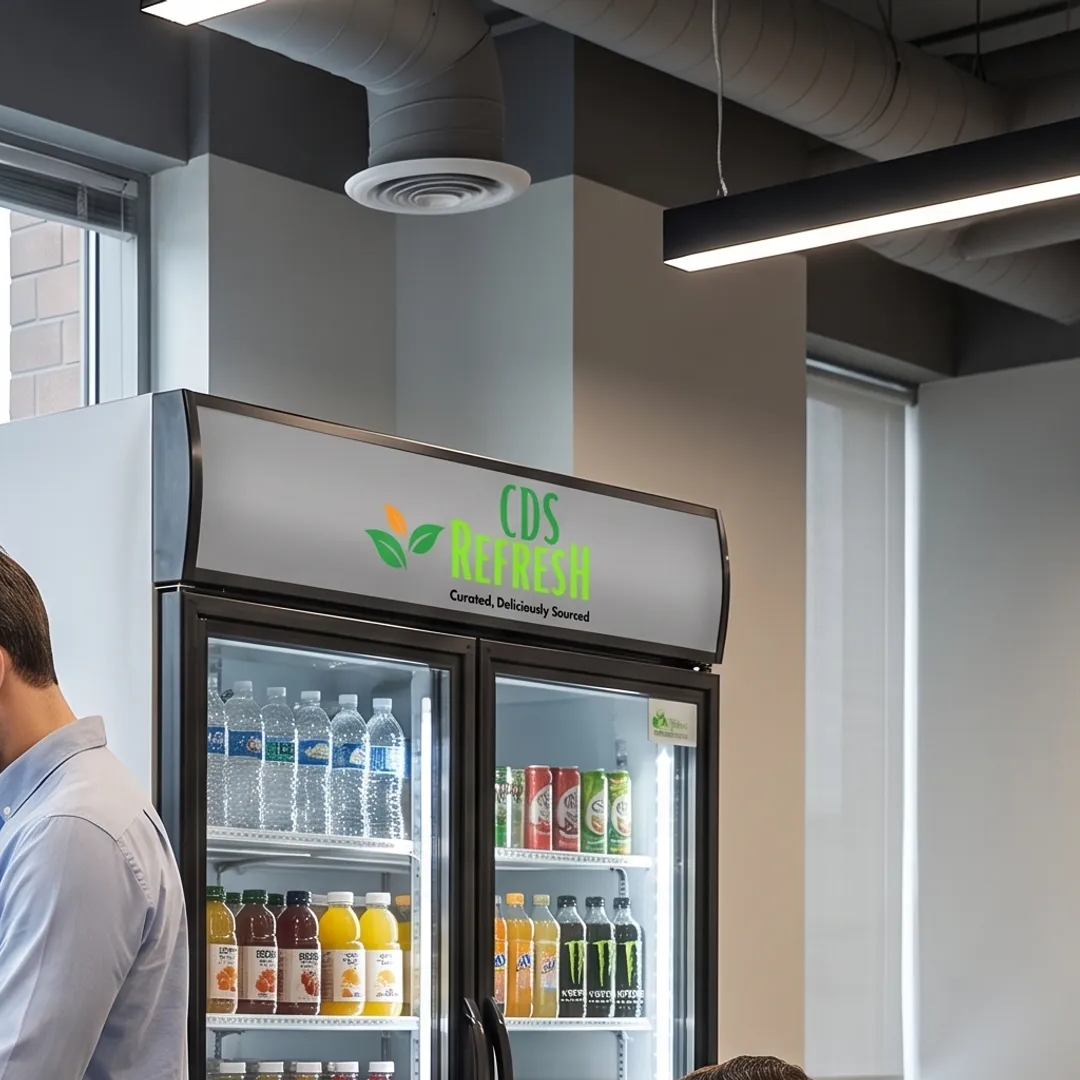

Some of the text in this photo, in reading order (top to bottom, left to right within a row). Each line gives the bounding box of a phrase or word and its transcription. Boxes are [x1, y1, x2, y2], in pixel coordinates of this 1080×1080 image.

[500, 484, 560, 545] CDS
[450, 518, 592, 602] REFRESH
[449, 589, 495, 609] Curated,
[551, 606, 590, 622] Sourced
